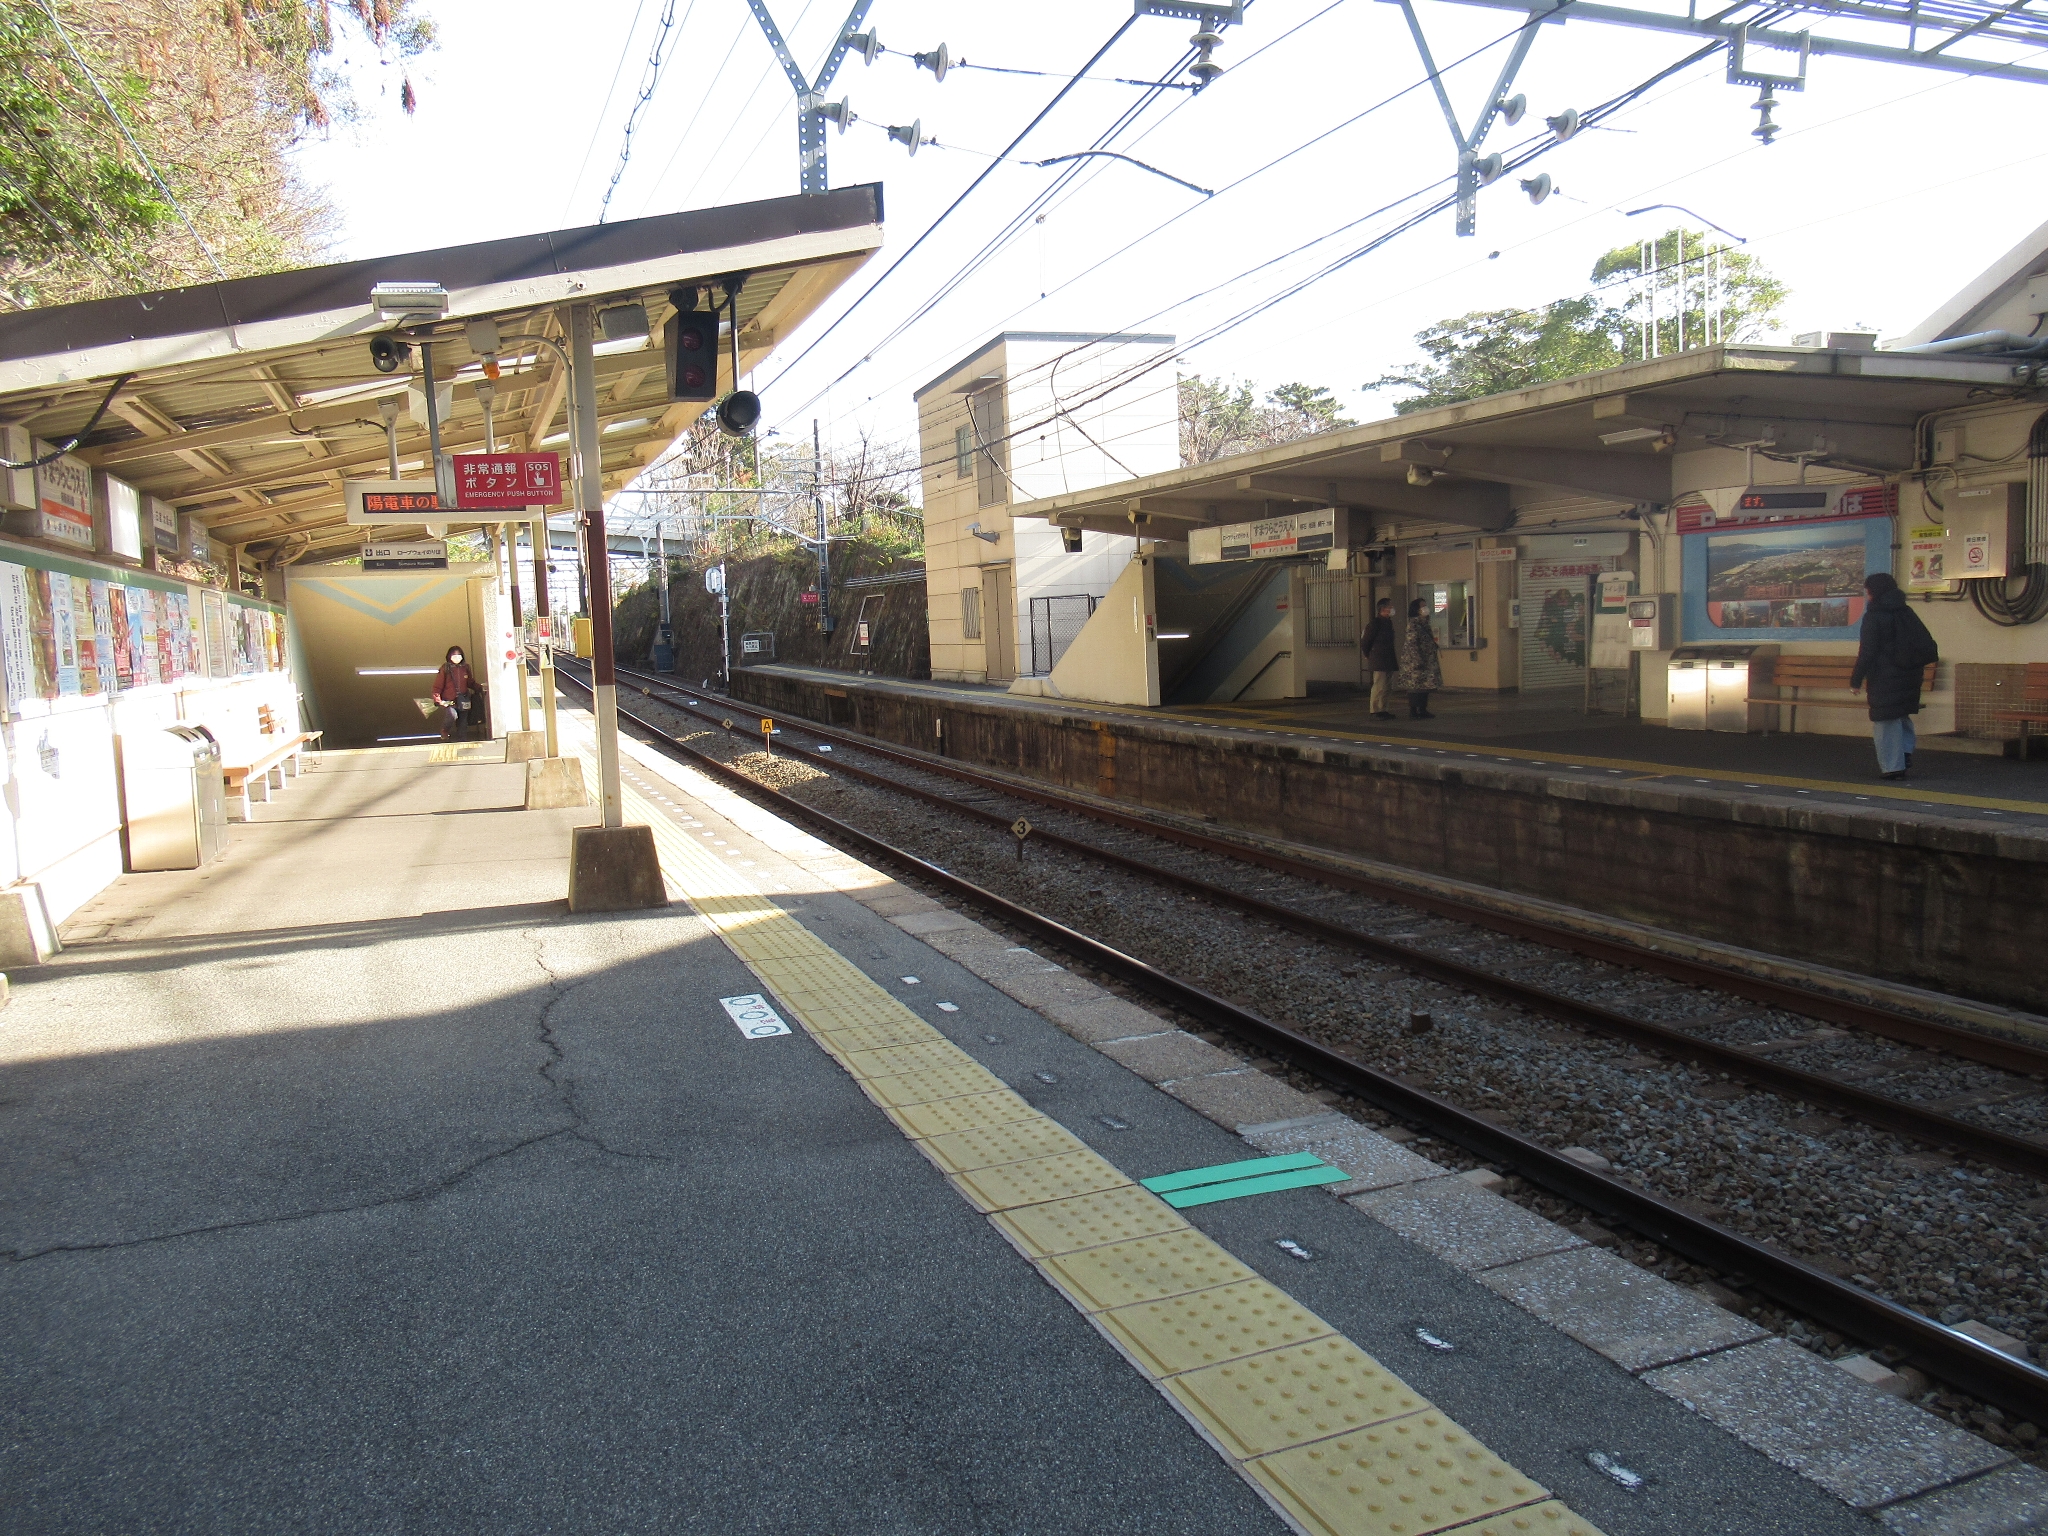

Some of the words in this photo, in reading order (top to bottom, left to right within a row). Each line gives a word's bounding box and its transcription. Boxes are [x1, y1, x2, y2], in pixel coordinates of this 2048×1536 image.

[463, 462, 517, 476] 非常通報
[528, 463, 549, 471] SOS
[465, 477, 517, 489] ボタン
[1253, 519, 1295, 537] すまうらこうえん
[375, 549, 391, 557] 出口
[725, 720, 730, 728] 4
[762, 721, 771, 731] A
[1017, 821, 1026, 834] 3
